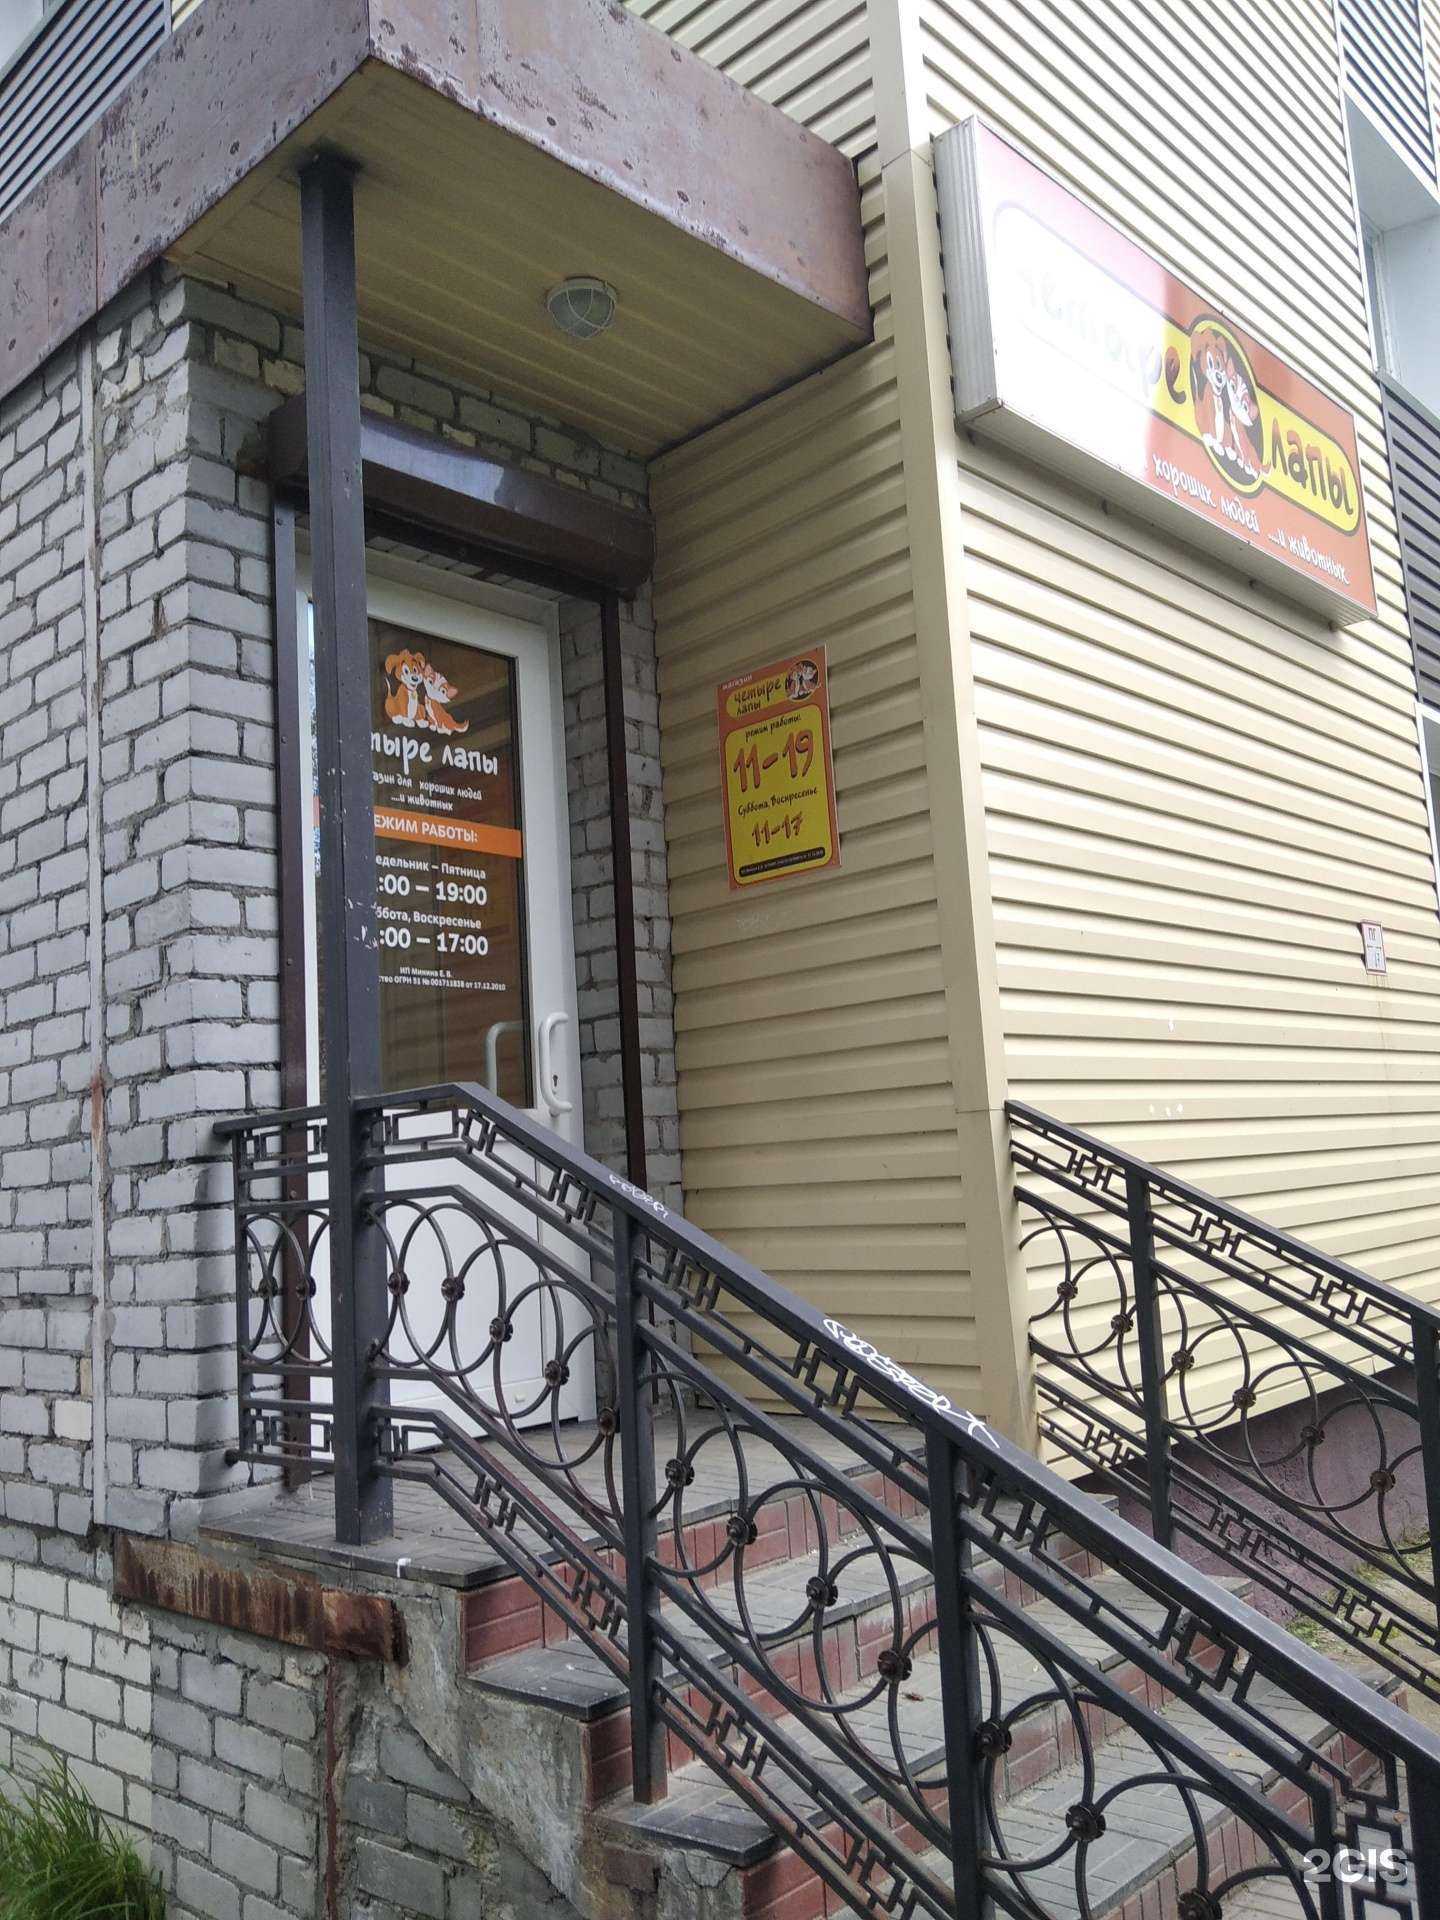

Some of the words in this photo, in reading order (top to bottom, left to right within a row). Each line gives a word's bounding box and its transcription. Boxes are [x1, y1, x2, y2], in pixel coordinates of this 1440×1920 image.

[1271, 416, 1354, 516] лапы
[1152, 454, 1216, 508] хороших
[1220, 494, 1260, 534] людей
[1288, 536, 1350, 585] животных
[722, 674, 752, 690] магазин
[734, 678, 782, 702] четыре
[736, 701, 761, 717] лапы
[745, 725, 768, 742] режим
[442, 744, 498, 775] лапы
[397, 773, 412, 788] для
[419, 780, 455, 796] хороших
[457, 787, 482, 800] людей
[407, 794, 453, 811] животных
[373, 814, 418, 833] ЕЖИМ
[421, 821, 478, 843] РАБОТЫ:
[376, 855, 429, 872] едельник
[441, 862, 487, 880] Пятница
[435, 881, 488, 906] 19:00
[413, 911, 482, 929] Воскресенье
[437, 932, 489, 955] 17:00
